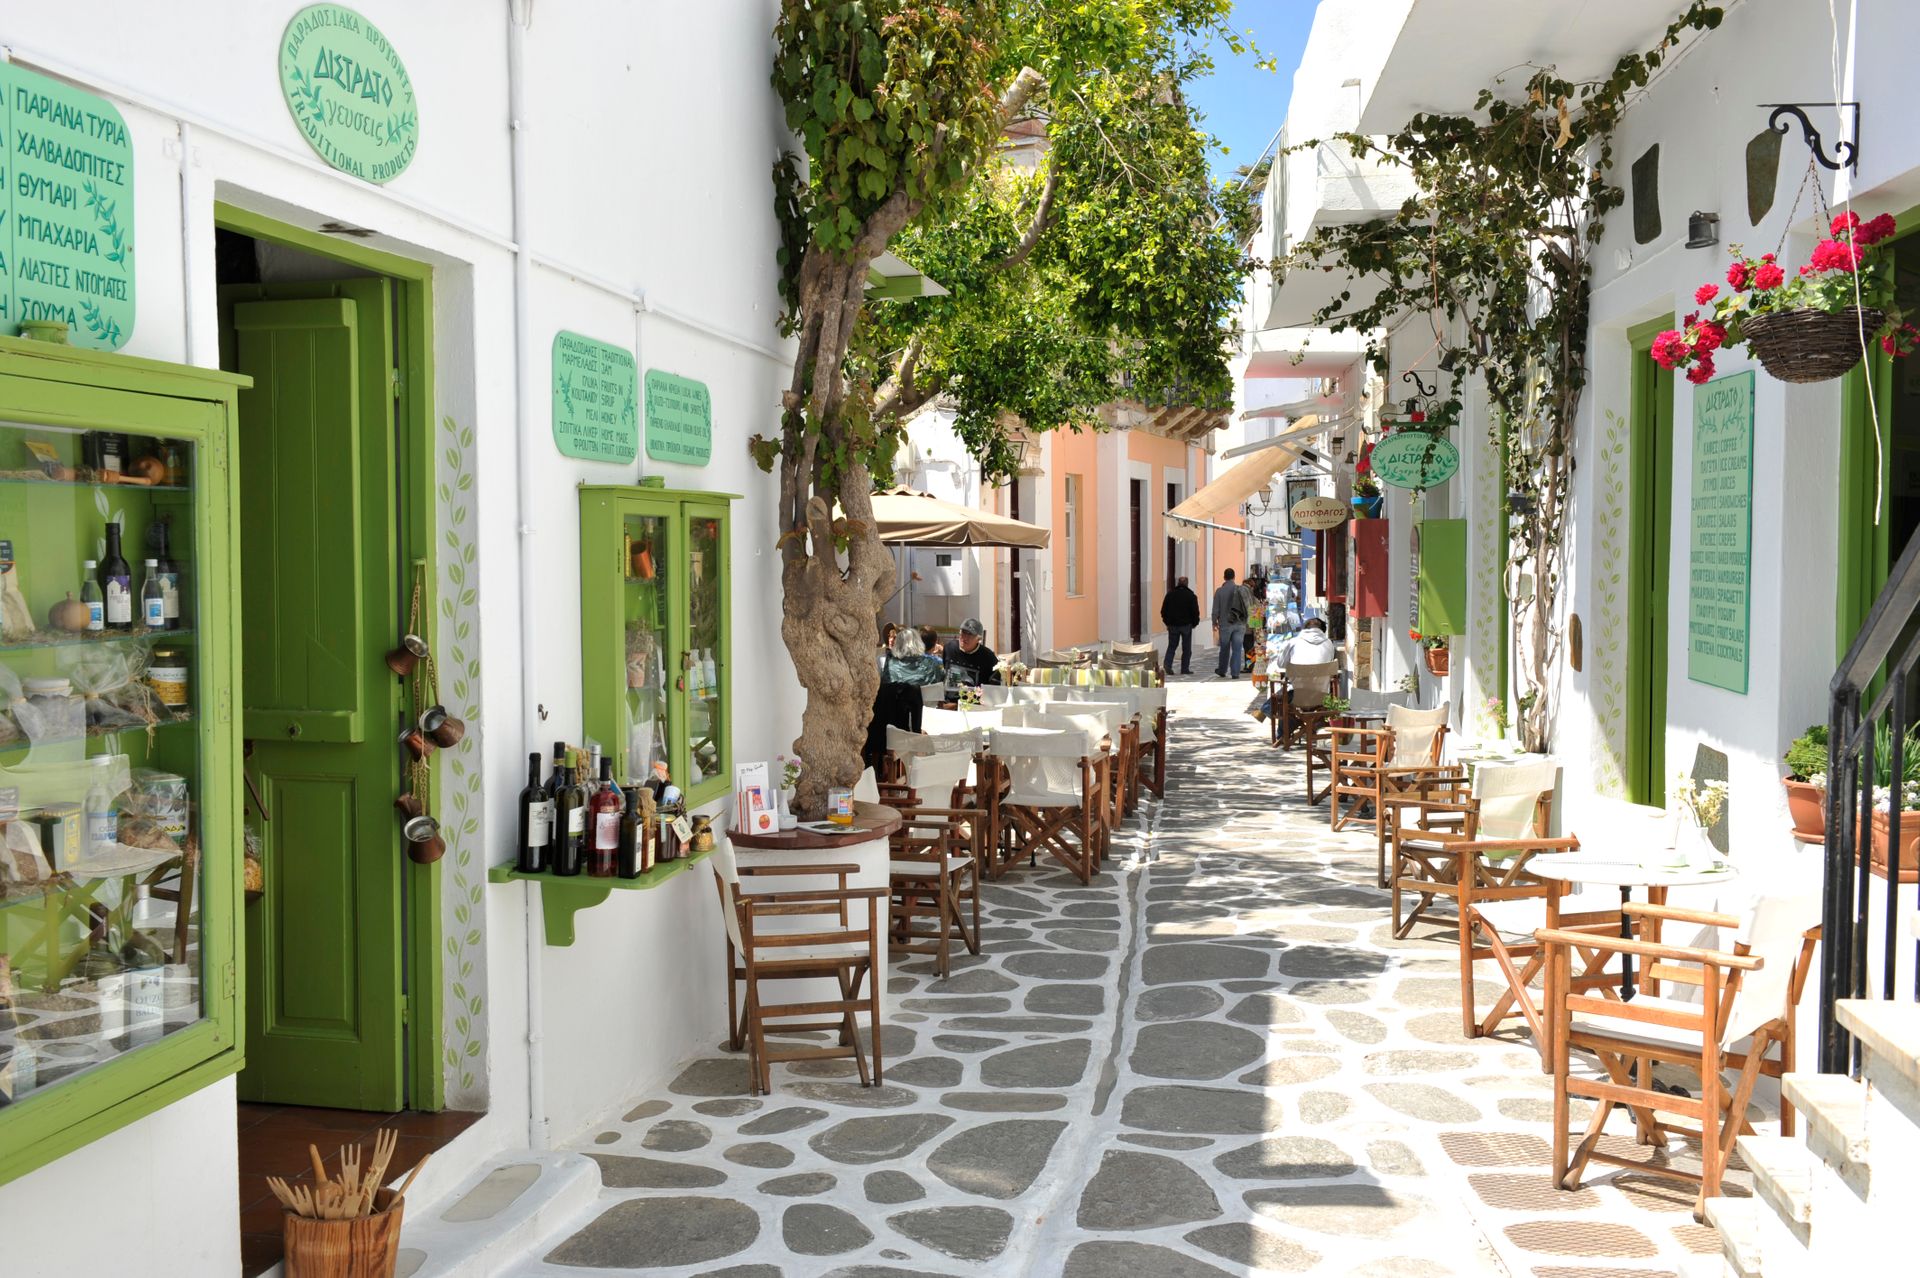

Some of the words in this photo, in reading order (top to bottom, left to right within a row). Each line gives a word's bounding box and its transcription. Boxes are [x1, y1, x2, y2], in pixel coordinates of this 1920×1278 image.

[287, 9, 360, 60] ΠΑΡΑΔΟΣΙΑΚΑ
[313, 45, 393, 108] ΔΙΣΤΡΑΤΟ
[16, 87, 84, 134] ΠΑΡΙΑΝΑ
[86, 111, 127, 148] ΤΥΡΙΑ
[290, 87, 365, 178] TRADITIONAL
[372, 136, 416, 180] PRODUCTS
[17, 129, 125, 186] ΧΑΛΒΑΔΟΠΙΤΕΣ
[18, 172, 77, 210] ΘΥΜΑΡΙ
[18, 213, 99, 257] ΜΠΑΧΑΡΙΑ
[18, 256, 71, 289] ΛΙΑΣΤΕΣ
[76, 269, 128, 302] ΝΤΟΜΑΤΕΣ
[1720, 437, 1737, 452] COFFEE
